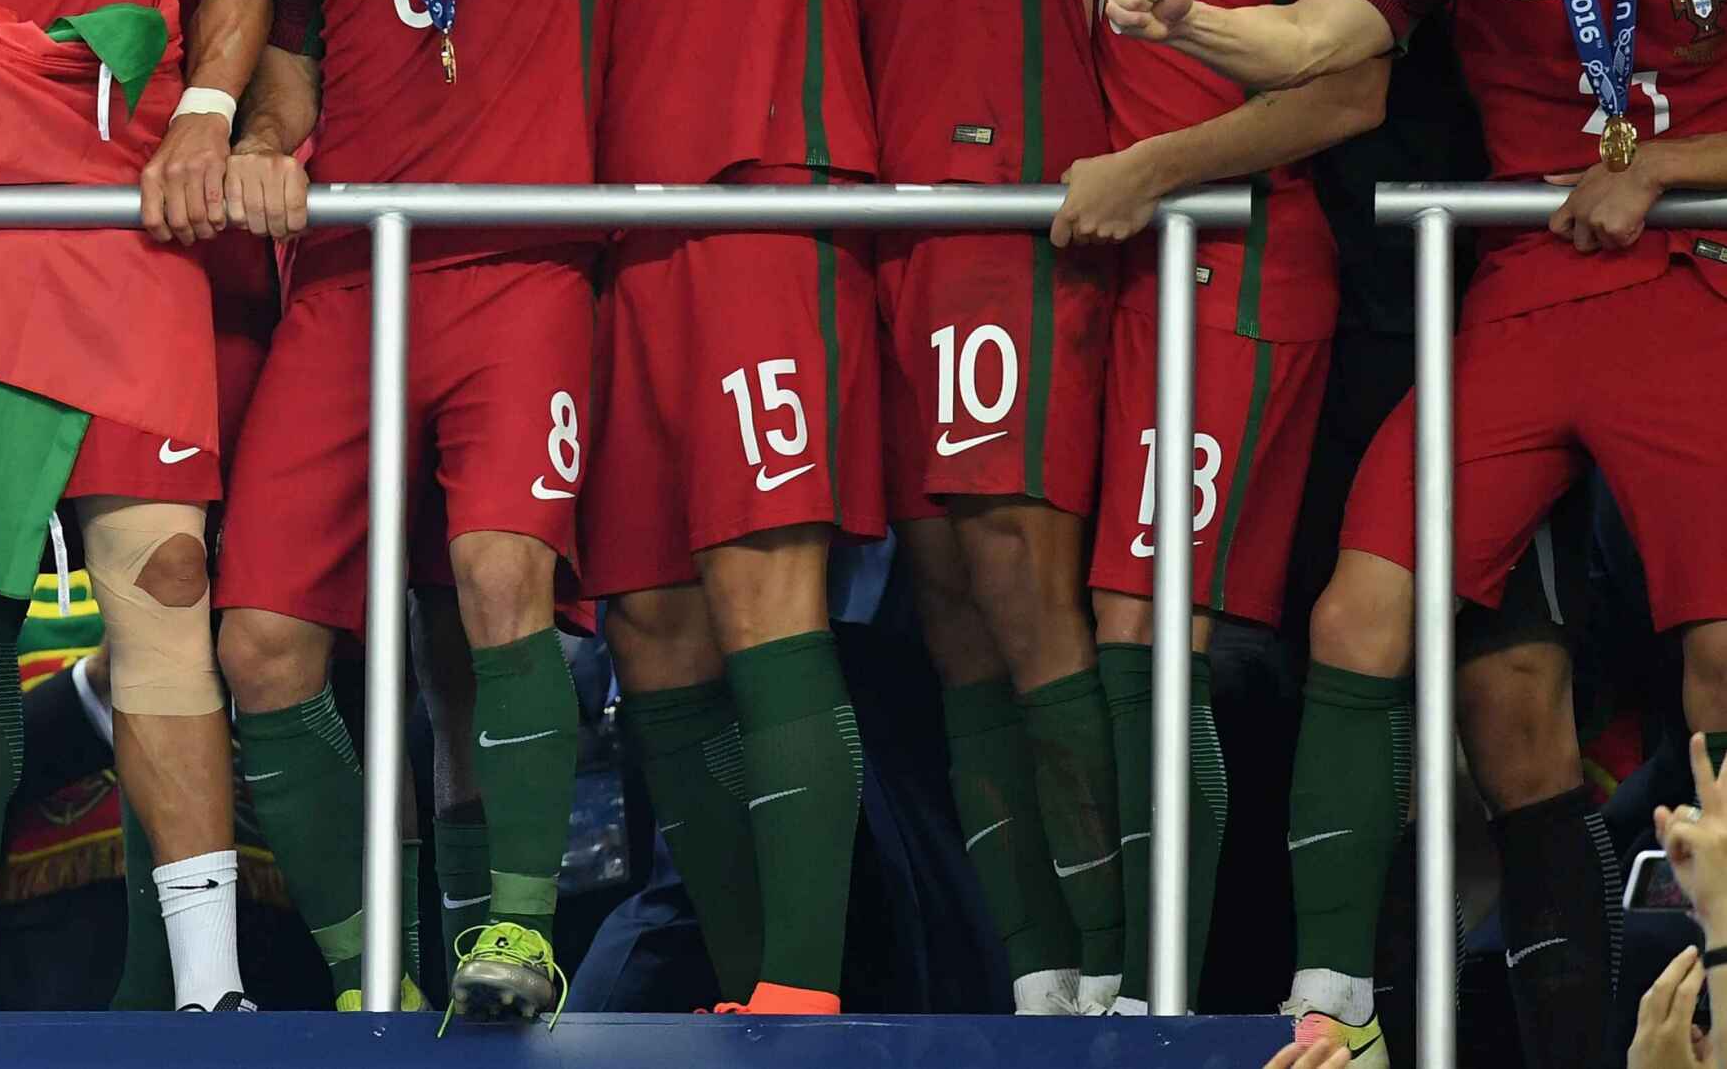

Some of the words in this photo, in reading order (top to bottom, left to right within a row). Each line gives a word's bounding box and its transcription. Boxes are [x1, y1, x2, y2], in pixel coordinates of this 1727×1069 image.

[720, 358, 810, 466] 15
[929, 323, 1019, 424] 10
[547, 389, 581, 485] 8
